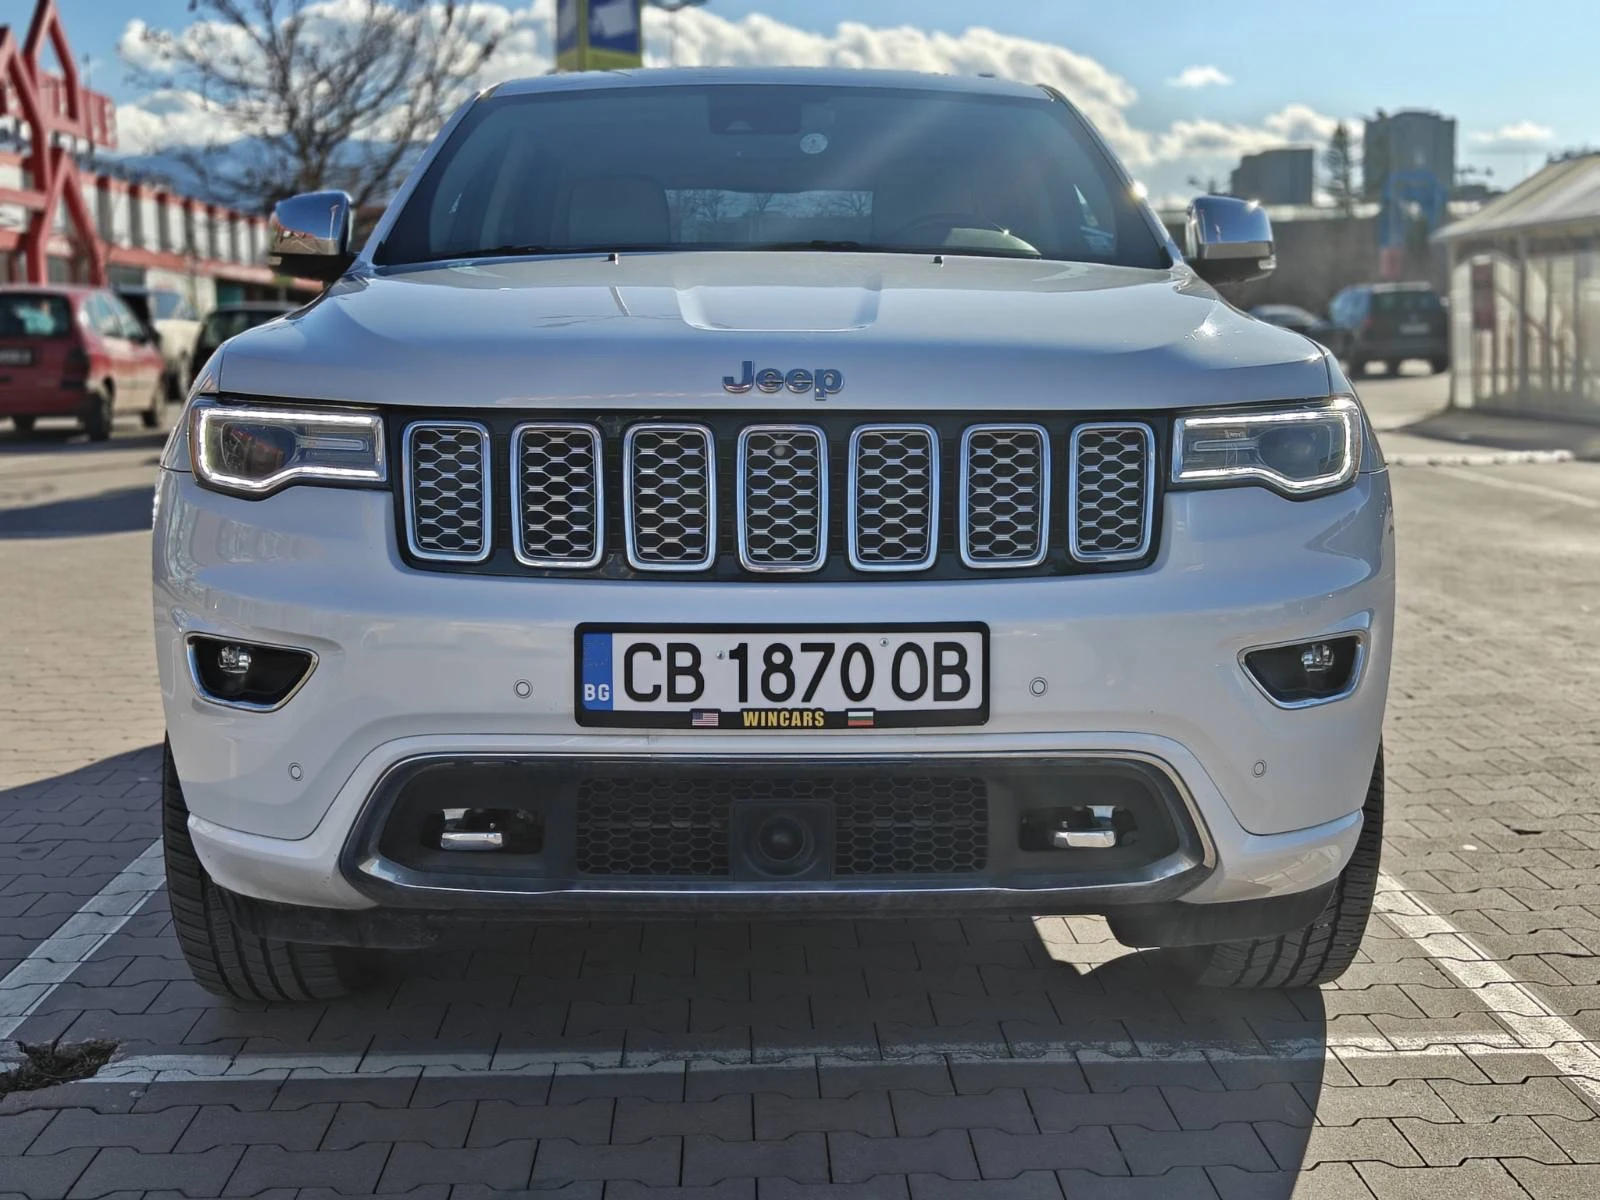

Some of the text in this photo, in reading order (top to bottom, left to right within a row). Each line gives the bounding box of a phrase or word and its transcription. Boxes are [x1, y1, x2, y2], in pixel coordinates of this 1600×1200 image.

[722, 360, 844, 401] Jeep
[624, 642, 705, 703] CB
[729, 642, 875, 703] 1870
[584, 683, 610, 701] BG
[742, 710, 825, 727] WINCARS
